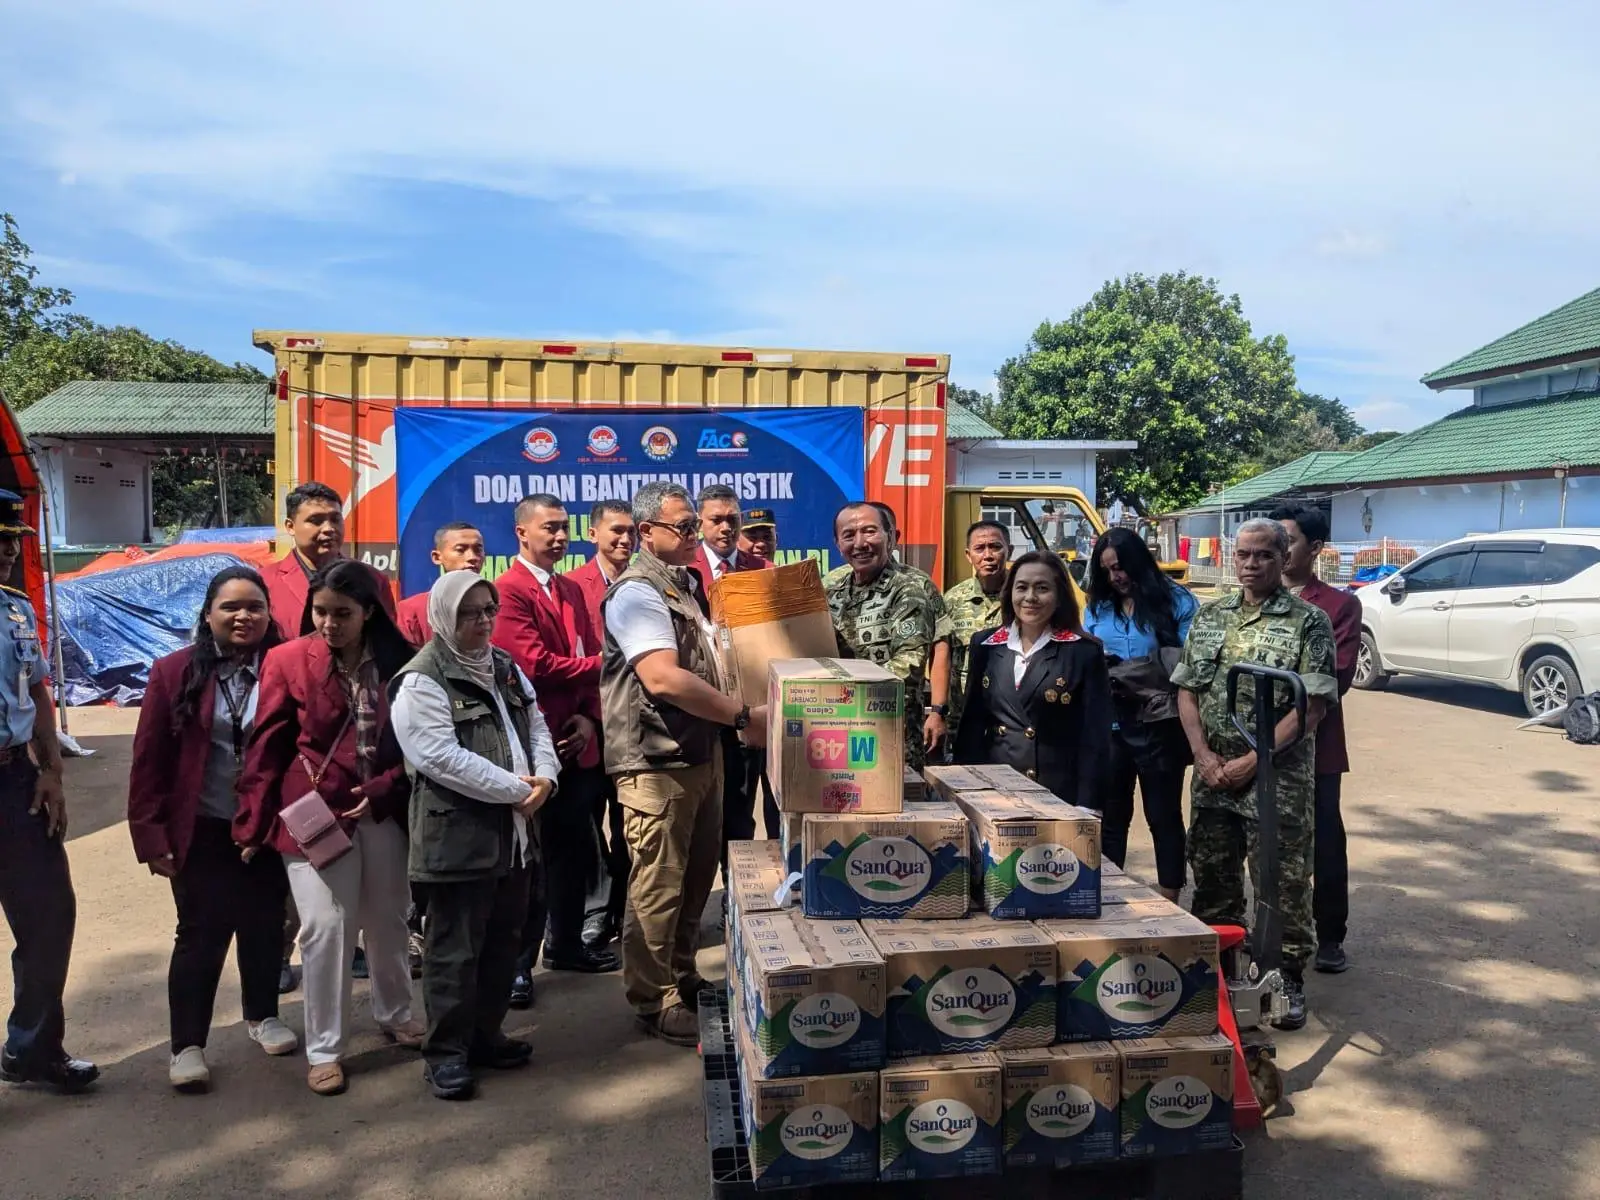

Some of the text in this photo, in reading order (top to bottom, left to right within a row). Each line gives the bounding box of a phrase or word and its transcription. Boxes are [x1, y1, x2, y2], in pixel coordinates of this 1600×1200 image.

[474, 475, 524, 503] DOA
[528, 475, 576, 502] DAN
[581, 474, 687, 502] BANTN
[859, 615, 872, 624] TNI
[1259, 635, 1294, 650] TNI AL
[810, 736, 844, 761] 48
[851, 736, 874, 762] M
[851, 859, 925, 880] SanQua
[1020, 861, 1075, 878] SanQua
[1101, 979, 1176, 1000] SanQua
[931, 991, 1009, 1014] SanQua
[793, 1010, 856, 1029] SanQua
[1030, 1102, 1090, 1119] SanQua
[1150, 1093, 1207, 1110] SanQua
[784, 1122, 848, 1139] SanQua
[910, 1117, 971, 1135] SanQua
